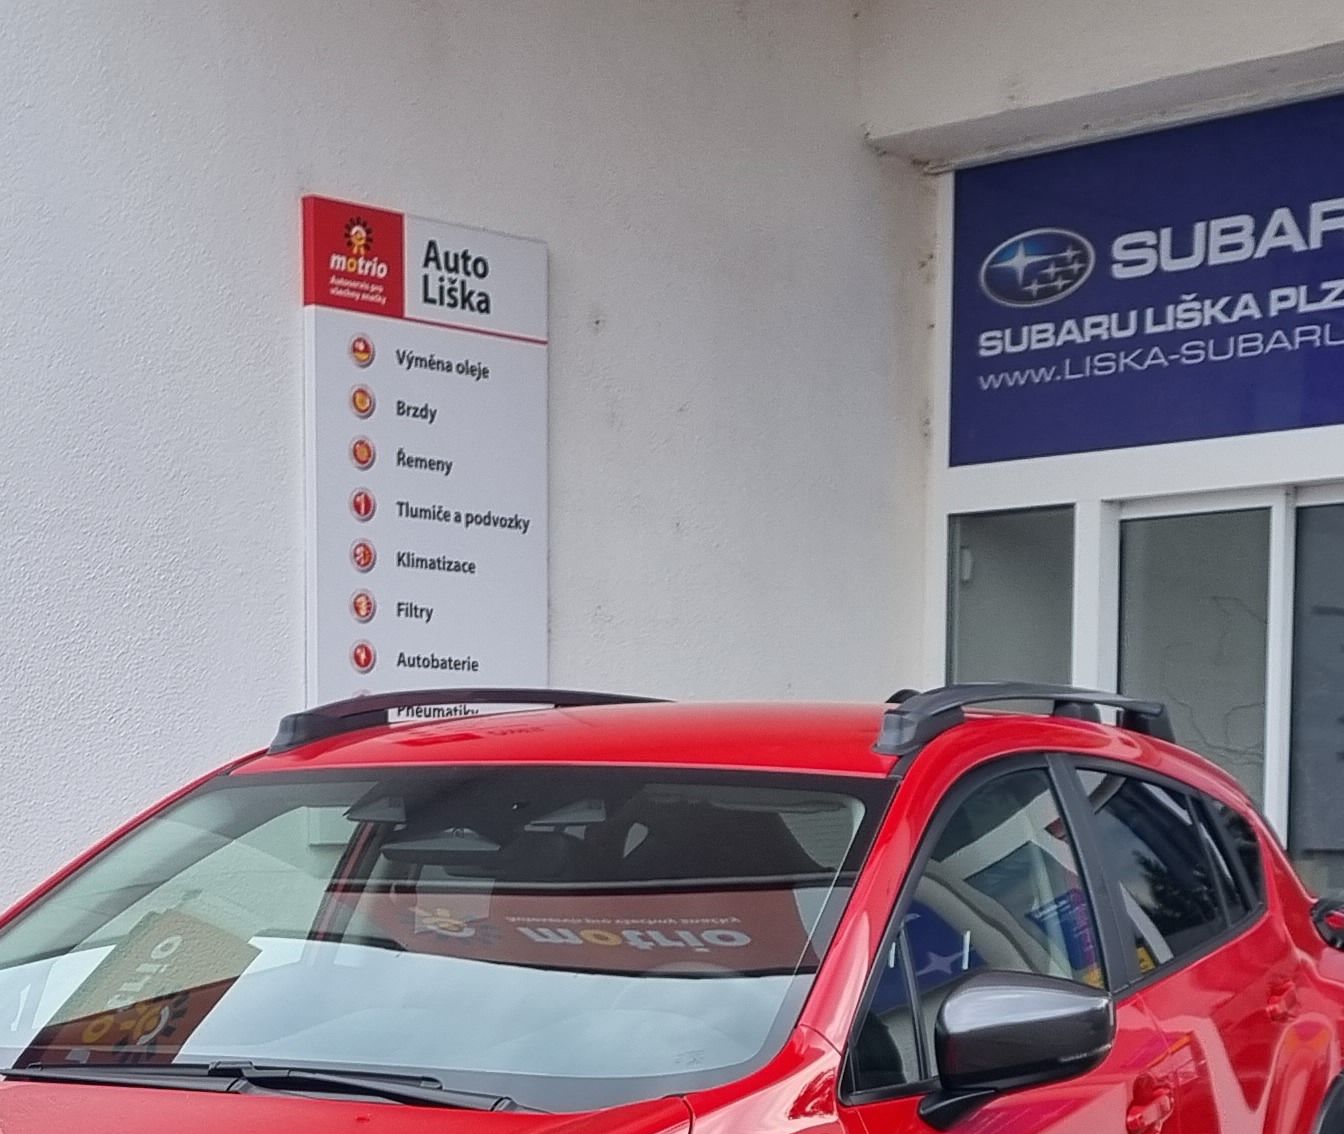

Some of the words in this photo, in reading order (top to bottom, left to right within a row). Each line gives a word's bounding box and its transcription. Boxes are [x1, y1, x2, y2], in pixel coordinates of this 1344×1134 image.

[329, 253, 388, 278] motrio
[422, 239, 490, 280] Auto
[422, 274, 491, 314] Liška
[978, 309, 1138, 357] SUBARU
[1143, 293, 1262, 334] LIŠKA
[395, 348, 453, 374] Výměna
[455, 359, 490, 382] oleje
[396, 400, 438, 424] Brzdy
[396, 448, 454, 477] Řemeny
[396, 501, 451, 524] Tlumiče
[453, 510, 462, 524] a
[464, 509, 531, 534] podvozky
[396, 551, 476, 574] Klimatizace
[396, 602, 434, 624] Filtry
[396, 651, 479, 672] Autobaterie
